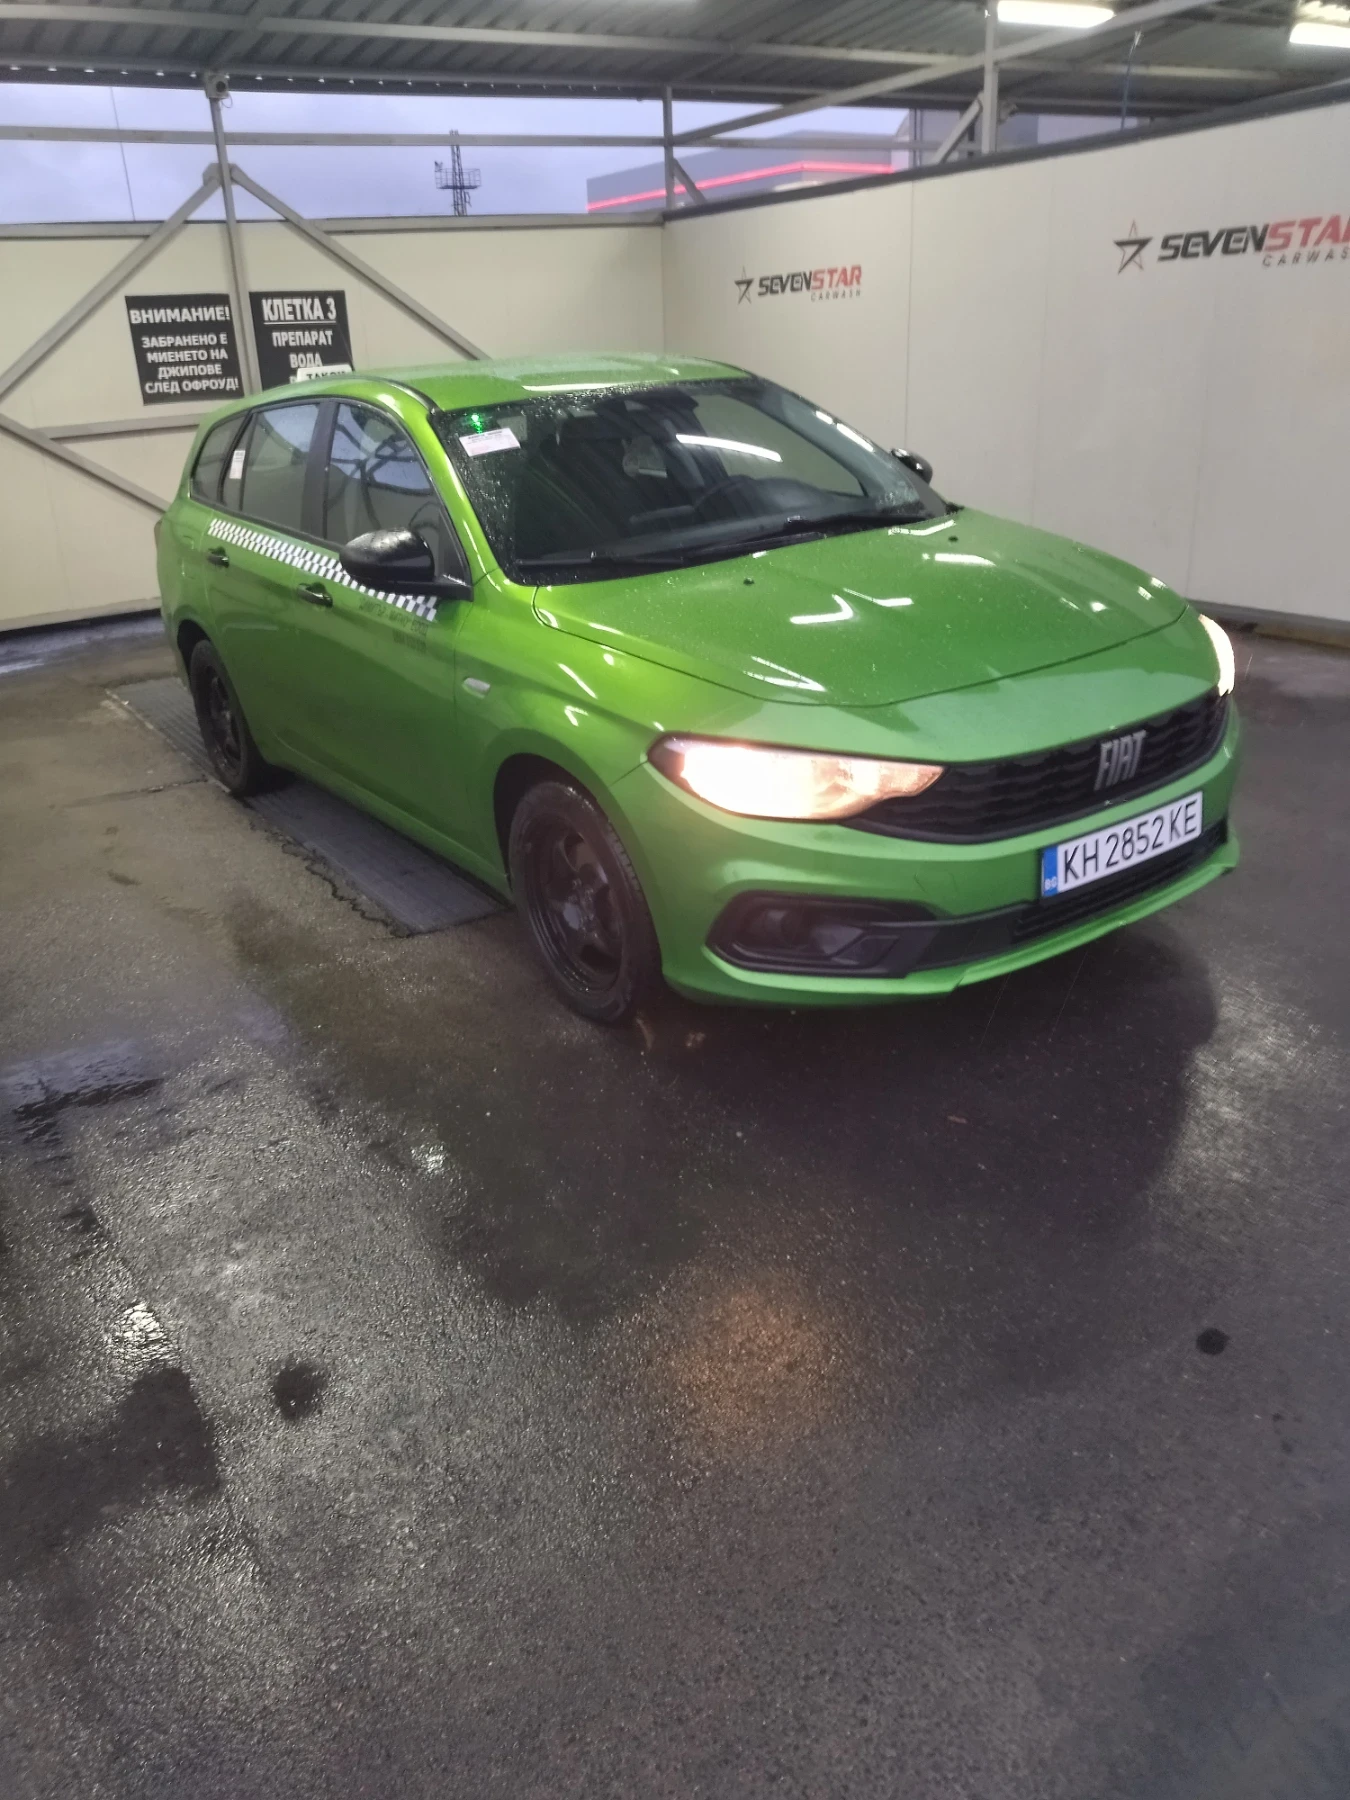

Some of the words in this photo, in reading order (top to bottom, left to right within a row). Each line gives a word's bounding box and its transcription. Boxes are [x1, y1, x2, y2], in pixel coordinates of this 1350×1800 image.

[1157, 214, 1350, 262] SEVENSTA
[1262, 246, 1350, 267] CARWAS
[757, 264, 862, 297] SEVENSTAR
[129, 305, 231, 324] ВНИМАНИЕ!
[261, 297, 325, 321] КЛЕТКА
[326, 296, 337, 320] 3
[141, 333, 217, 348] ЗАБРАНЕНО
[219, 332, 228, 345] Е
[271, 329, 333, 347] ПРЕПАРАТ
[146, 349, 208, 363] МИЕНЕТО
[210, 348, 228, 360] НА
[289, 352, 323, 368] ВОДА
[157, 364, 222, 380] ДЖИПОВЕ
[144, 380, 181, 394] СЛЕД
[182, 377, 239, 392] ОФРОУД!
[1094, 729, 1147, 791] FIAT
